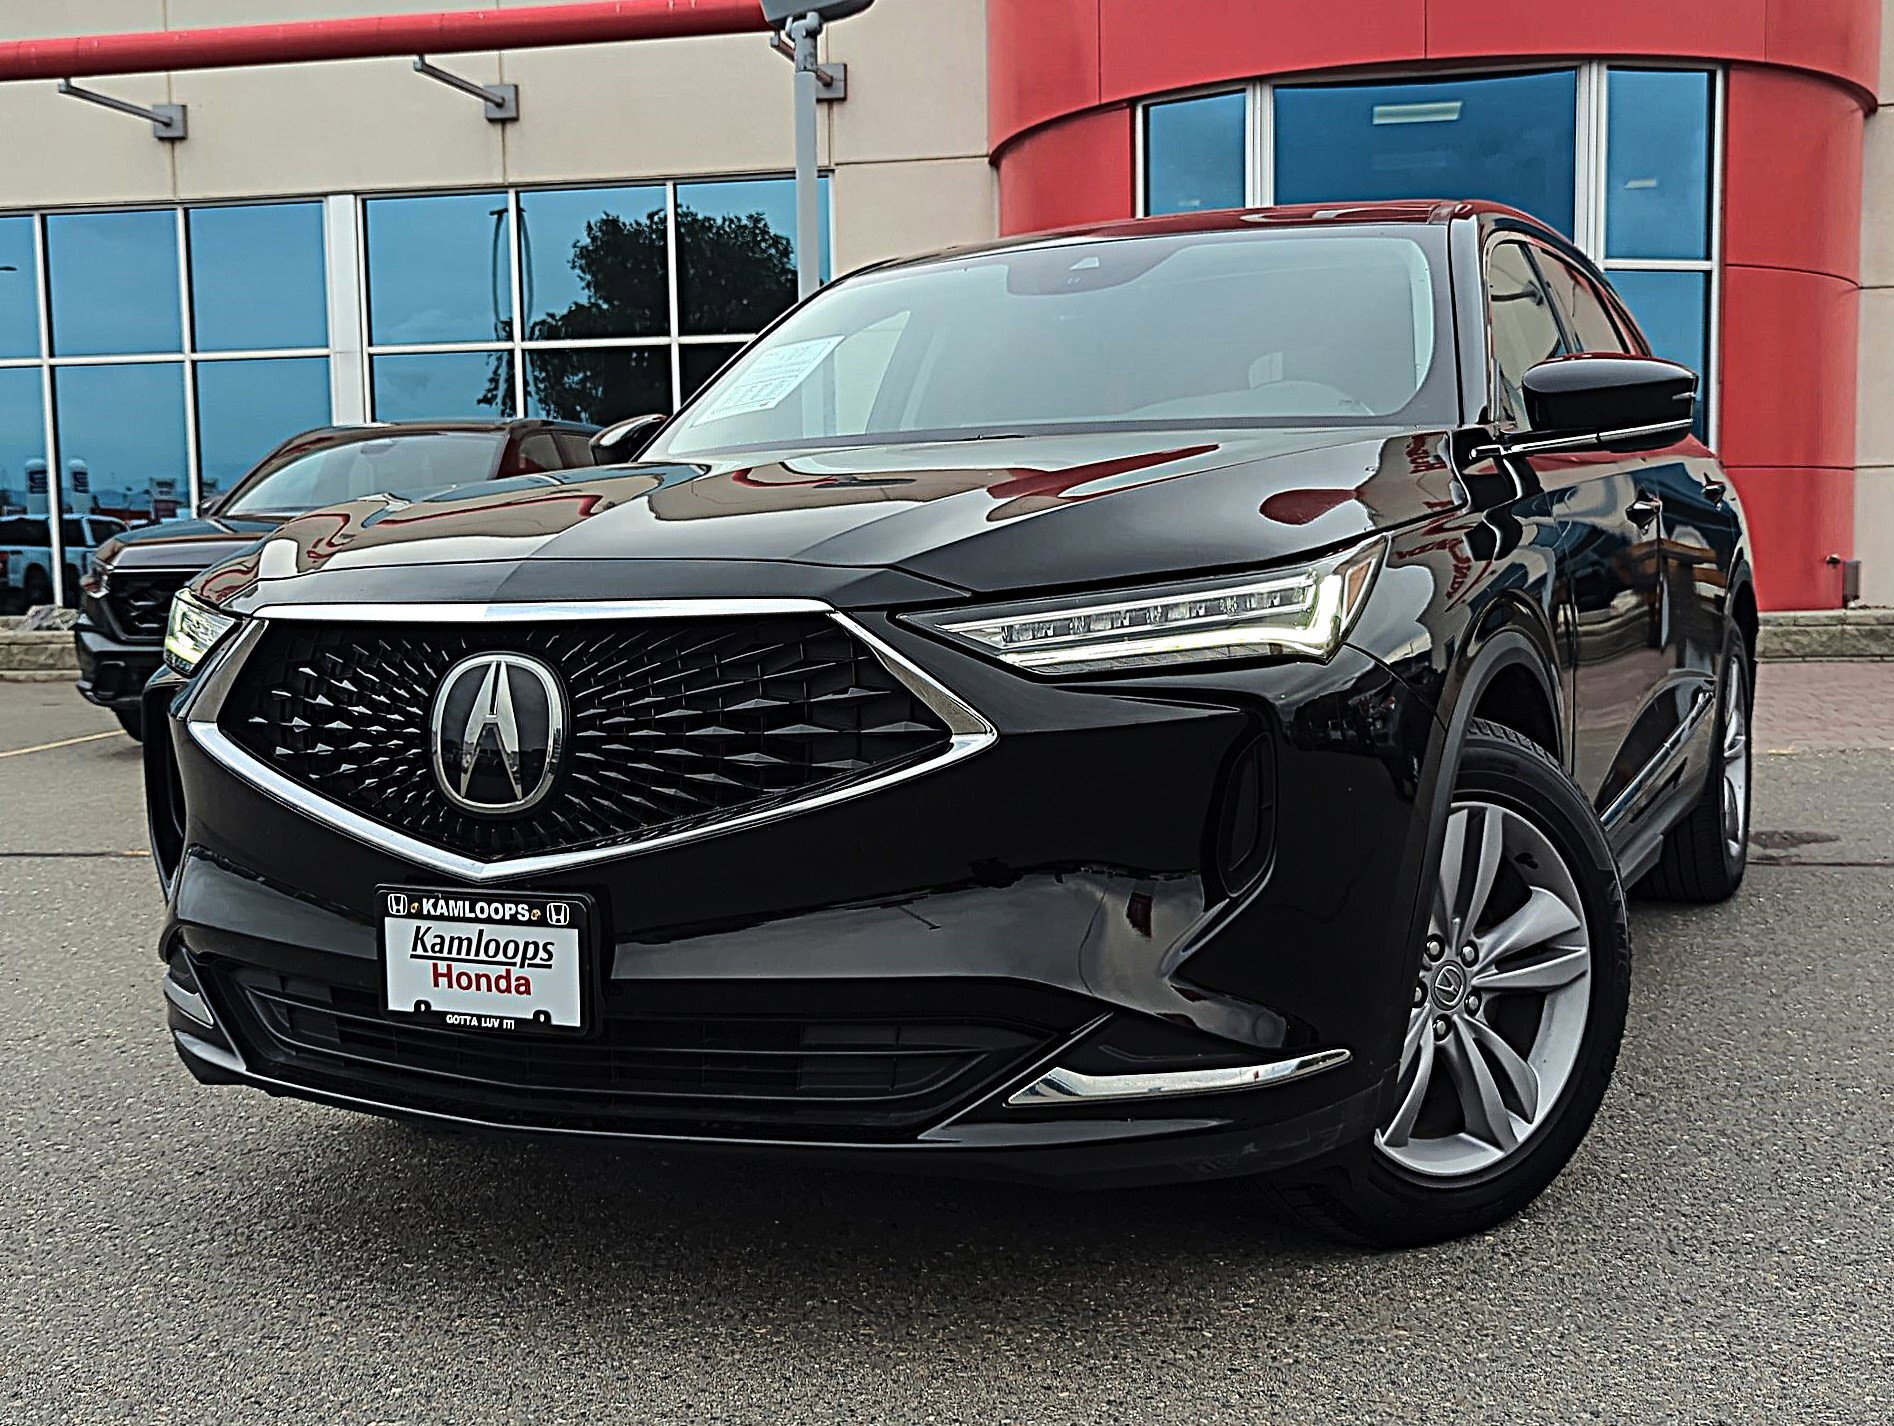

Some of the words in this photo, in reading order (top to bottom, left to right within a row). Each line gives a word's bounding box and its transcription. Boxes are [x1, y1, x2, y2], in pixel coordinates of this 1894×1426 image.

[422, 898, 530, 921] KAMLOOPS
[410, 925, 555, 969] Kamloops
[431, 962, 532, 996] Honda
[446, 1014, 478, 1026] GOTTA
[481, 1017, 500, 1029] LUV
